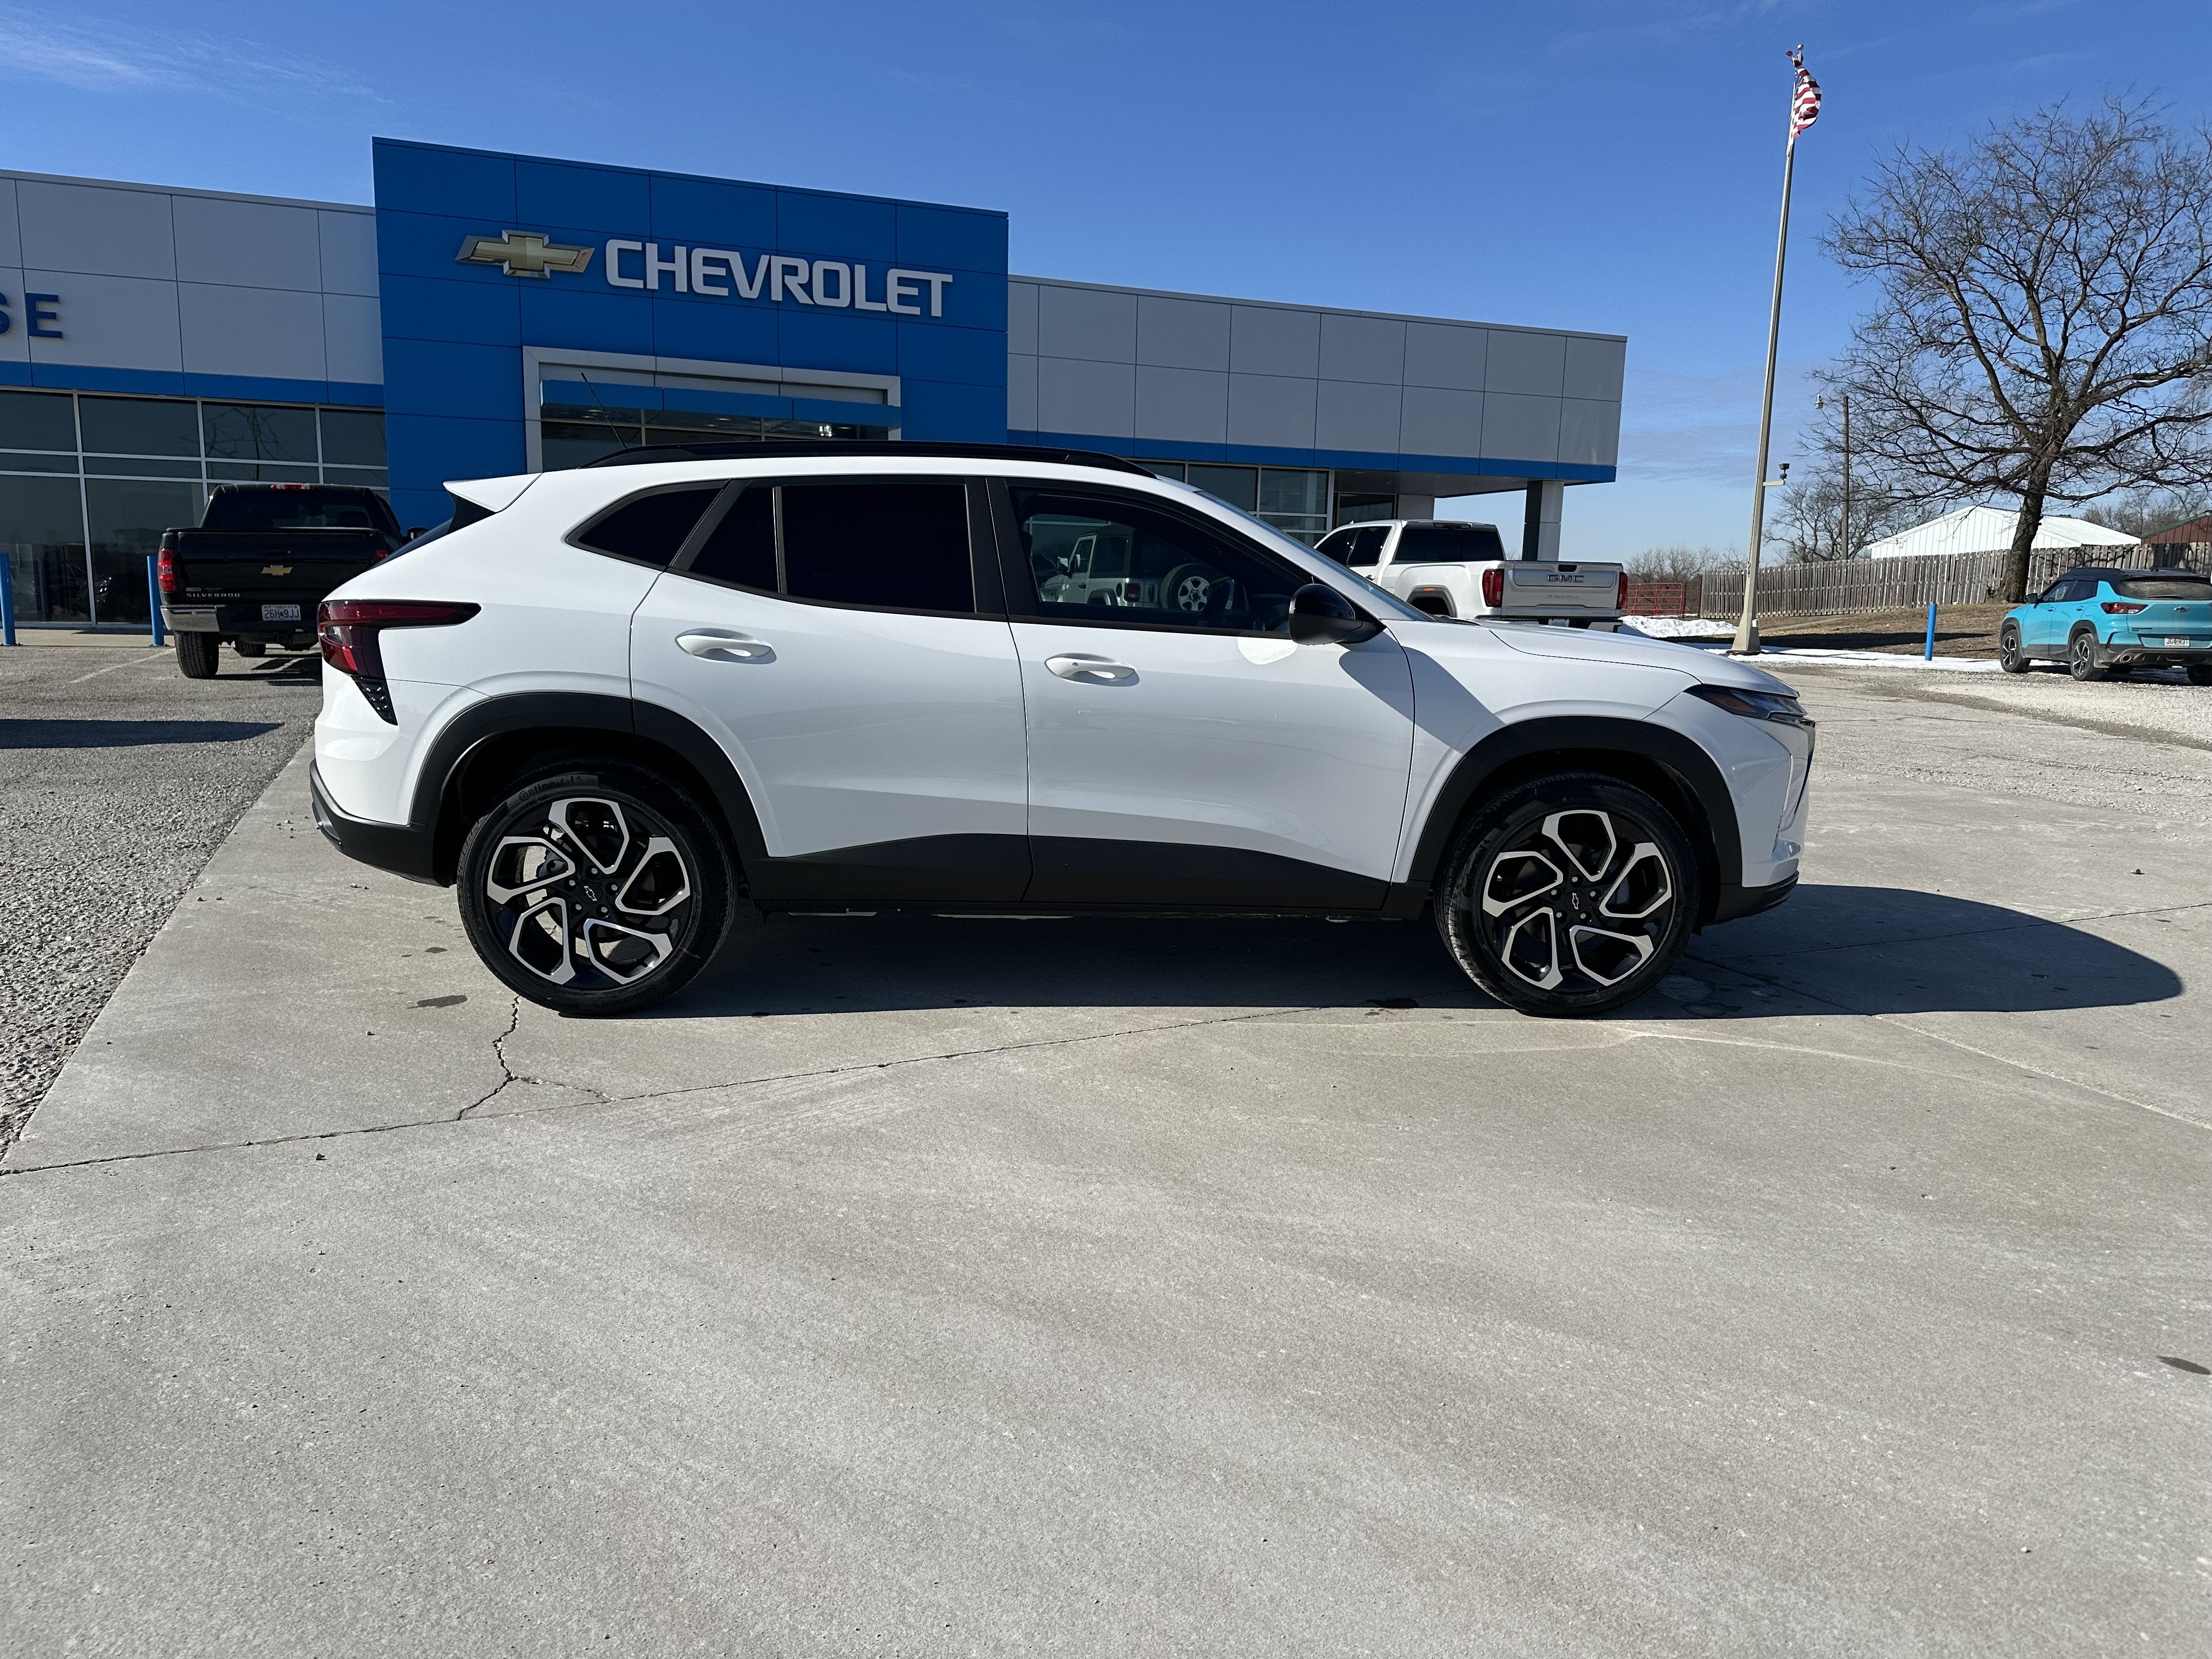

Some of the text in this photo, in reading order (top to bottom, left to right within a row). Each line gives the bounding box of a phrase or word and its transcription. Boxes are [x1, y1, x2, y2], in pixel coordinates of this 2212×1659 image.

[605, 239, 953, 317] CHEVROLET
[1547, 574, 1584, 583] GMC
[264, 608, 300, 619] 26H 9JJ
